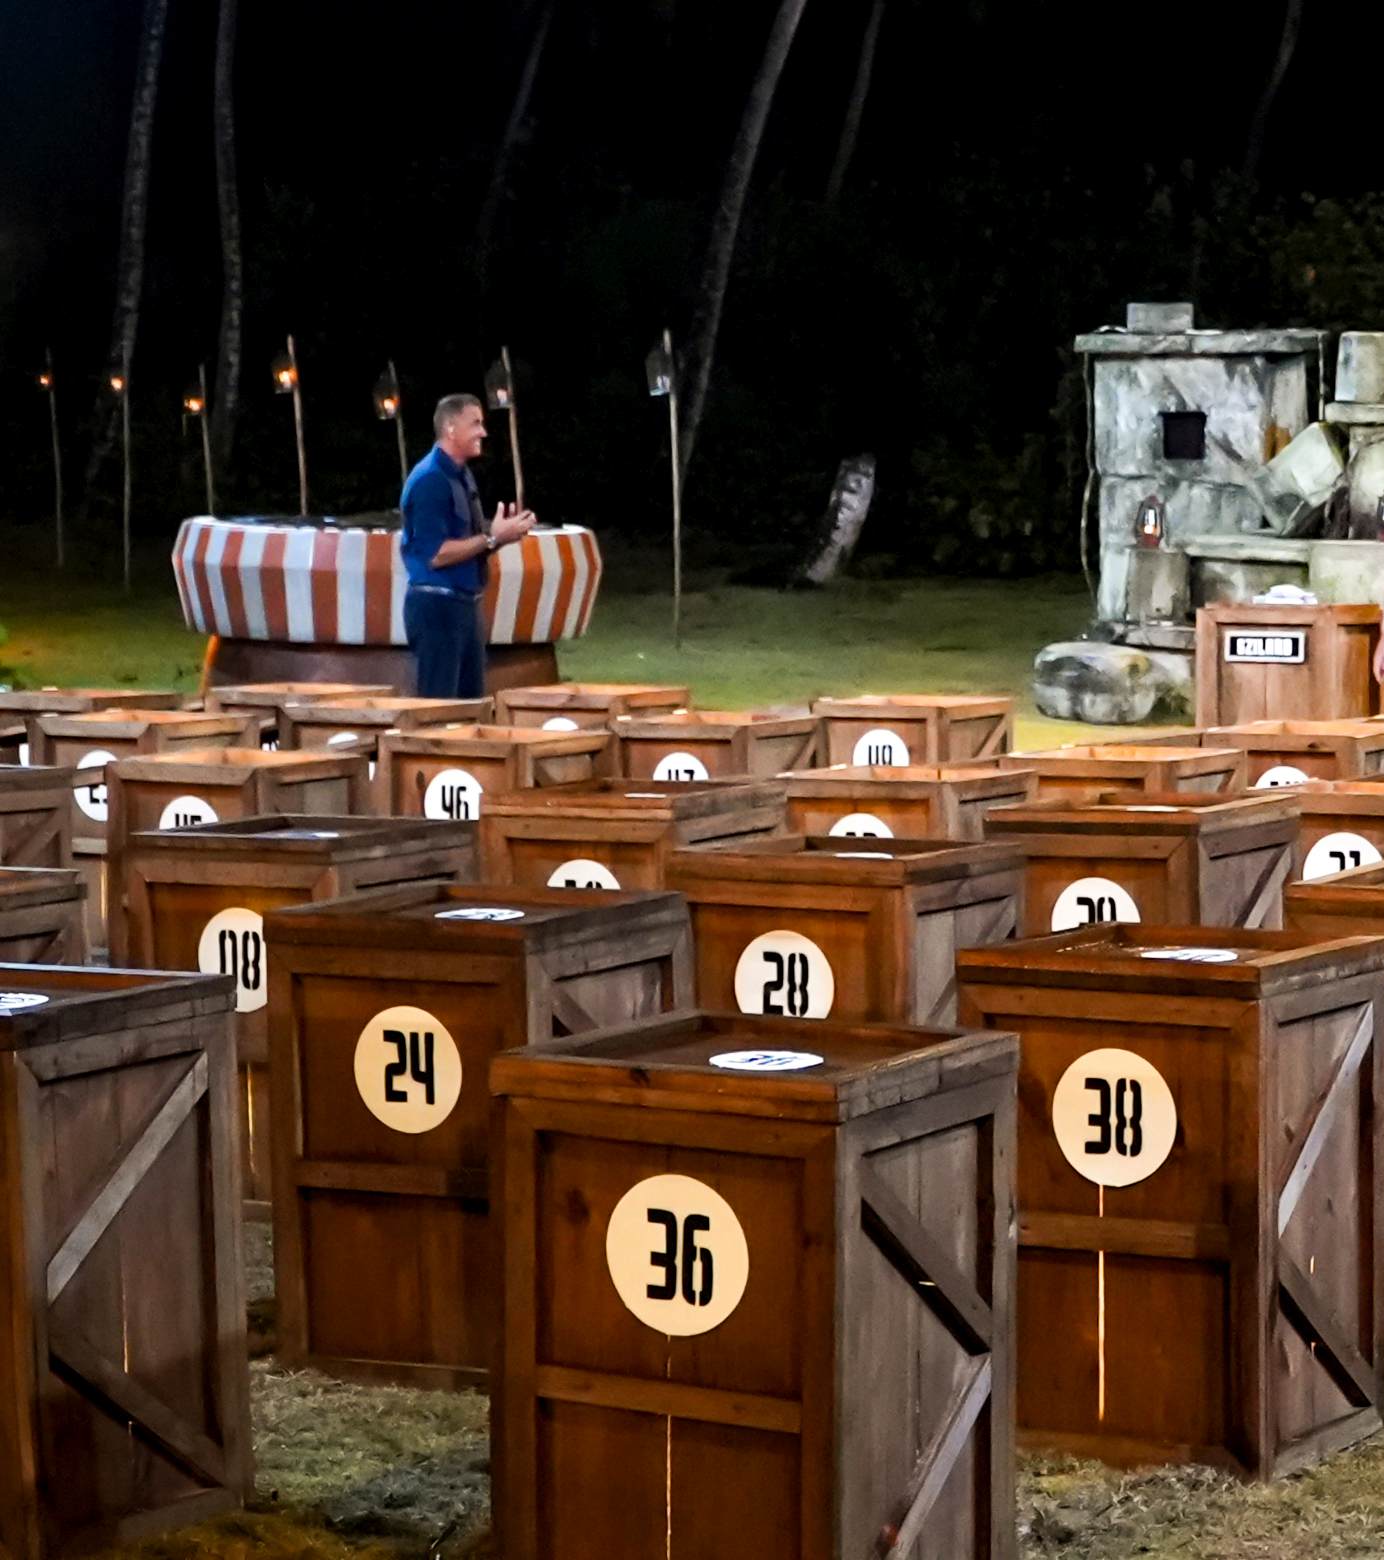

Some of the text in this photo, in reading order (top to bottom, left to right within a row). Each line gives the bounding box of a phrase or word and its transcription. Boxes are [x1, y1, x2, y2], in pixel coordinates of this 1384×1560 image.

[219, 929, 261, 991] 08
[762, 951, 809, 1017] 28
[383, 1029, 435, 1106] 24
[1084, 1077, 1143, 1158] 38
[647, 1207, 714, 1307] 36
